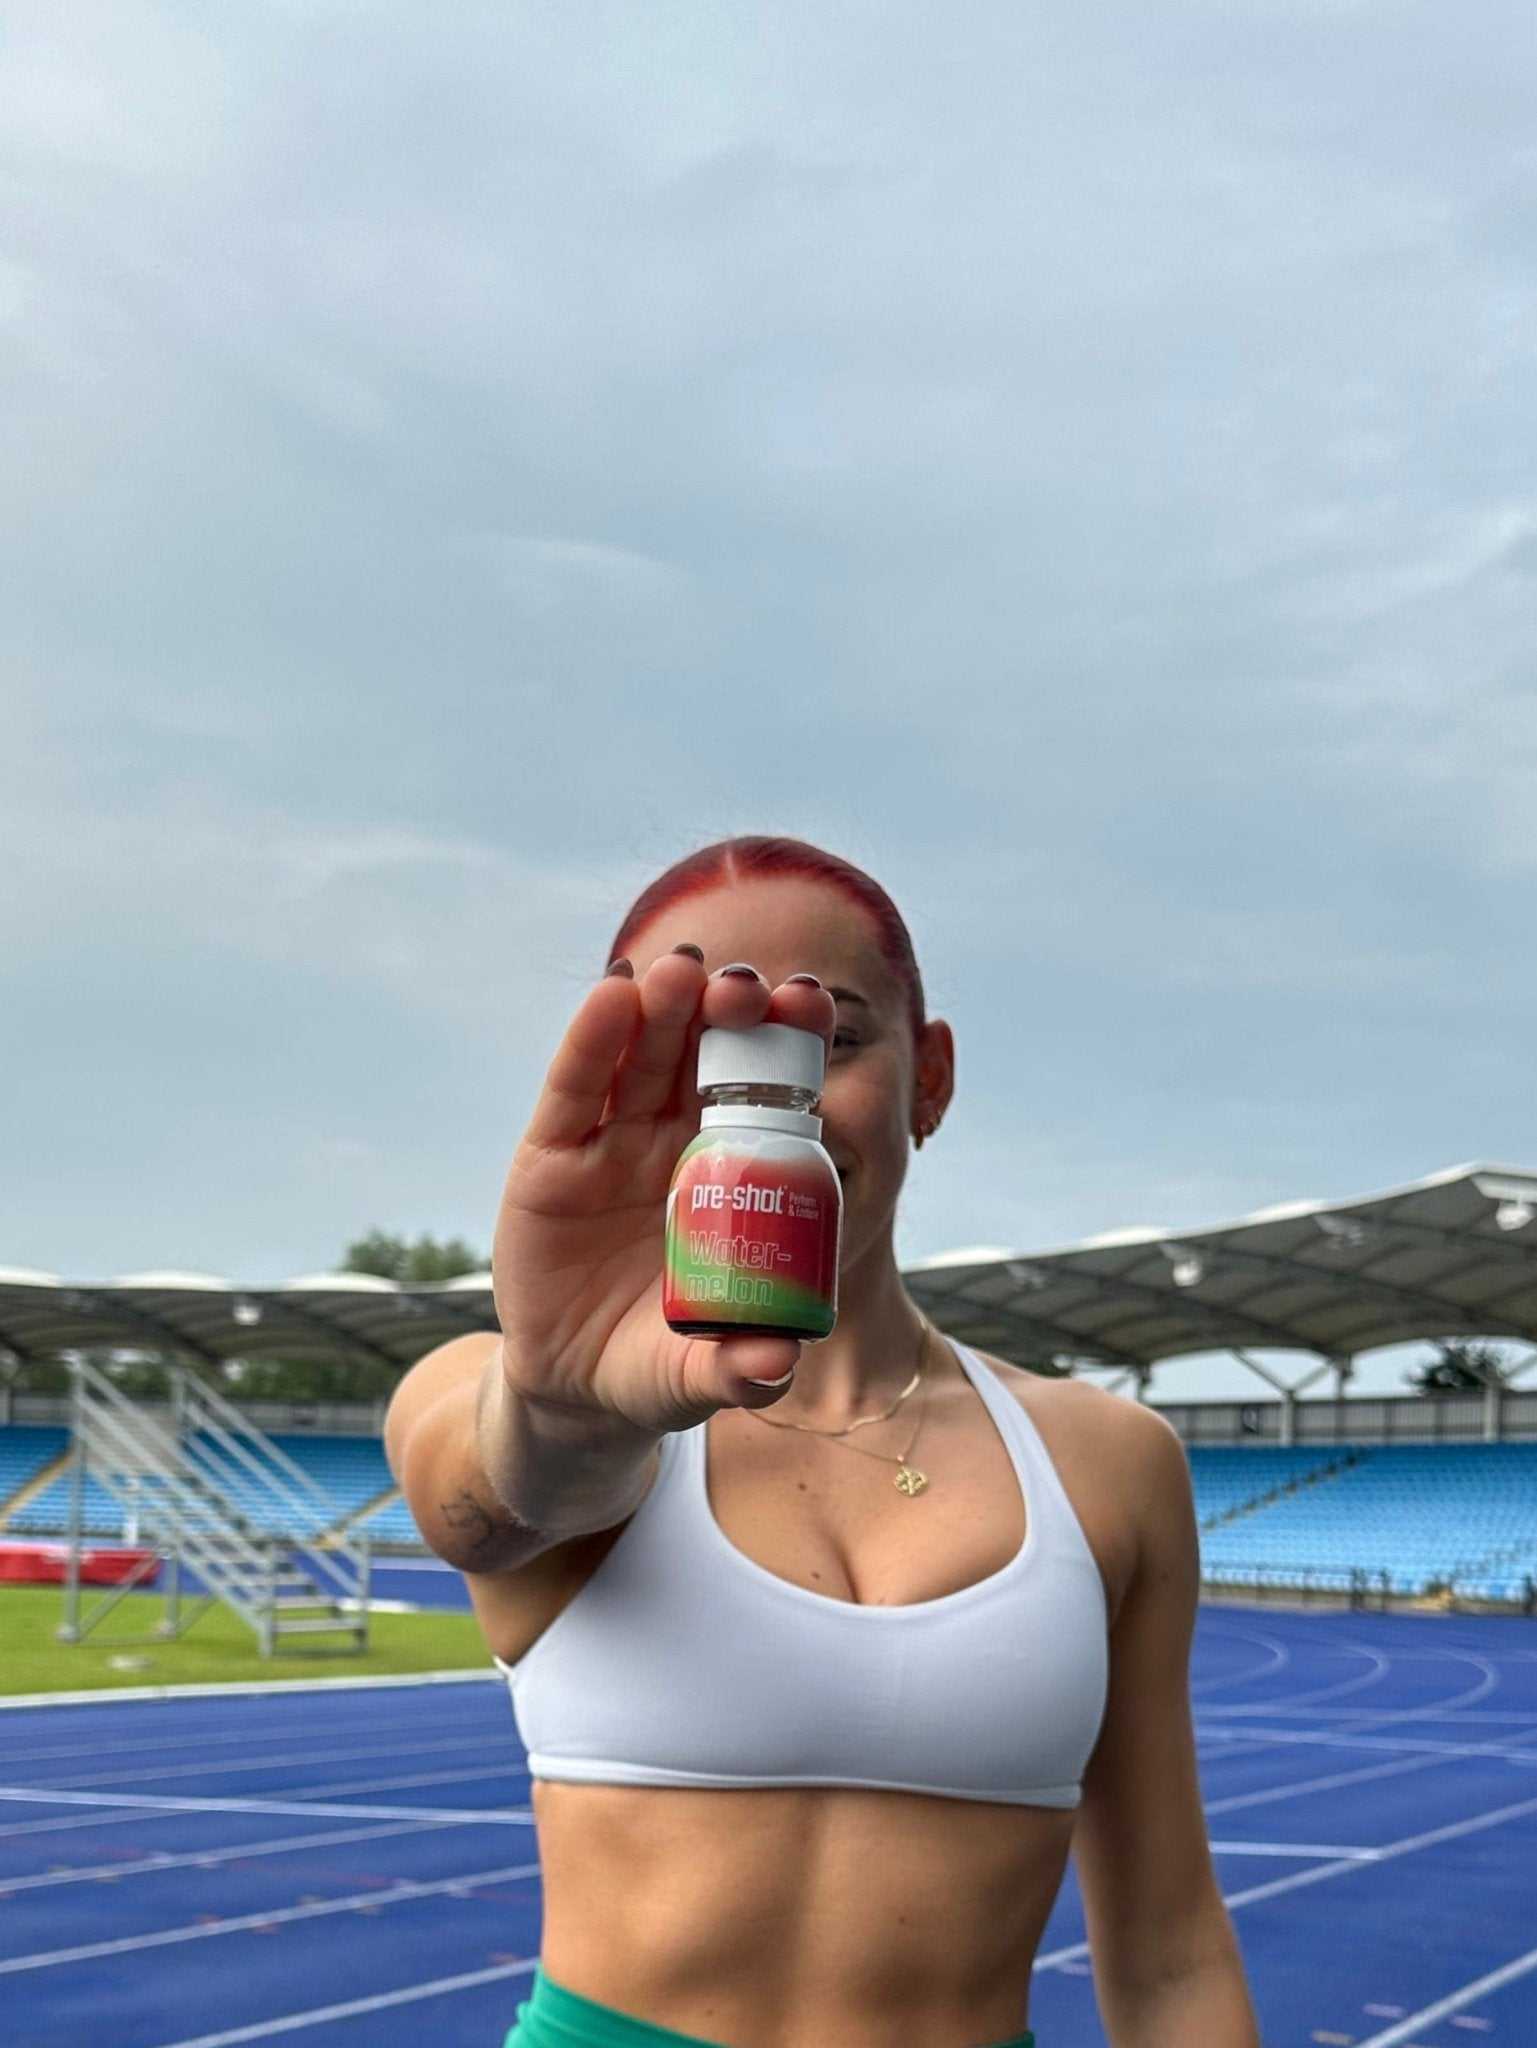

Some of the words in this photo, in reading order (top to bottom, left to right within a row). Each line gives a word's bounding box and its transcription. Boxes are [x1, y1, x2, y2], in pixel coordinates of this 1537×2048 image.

[691, 1183, 784, 1215] pre-shot
[689, 1230, 793, 1270] Water-
[685, 1267, 775, 1306] melon
